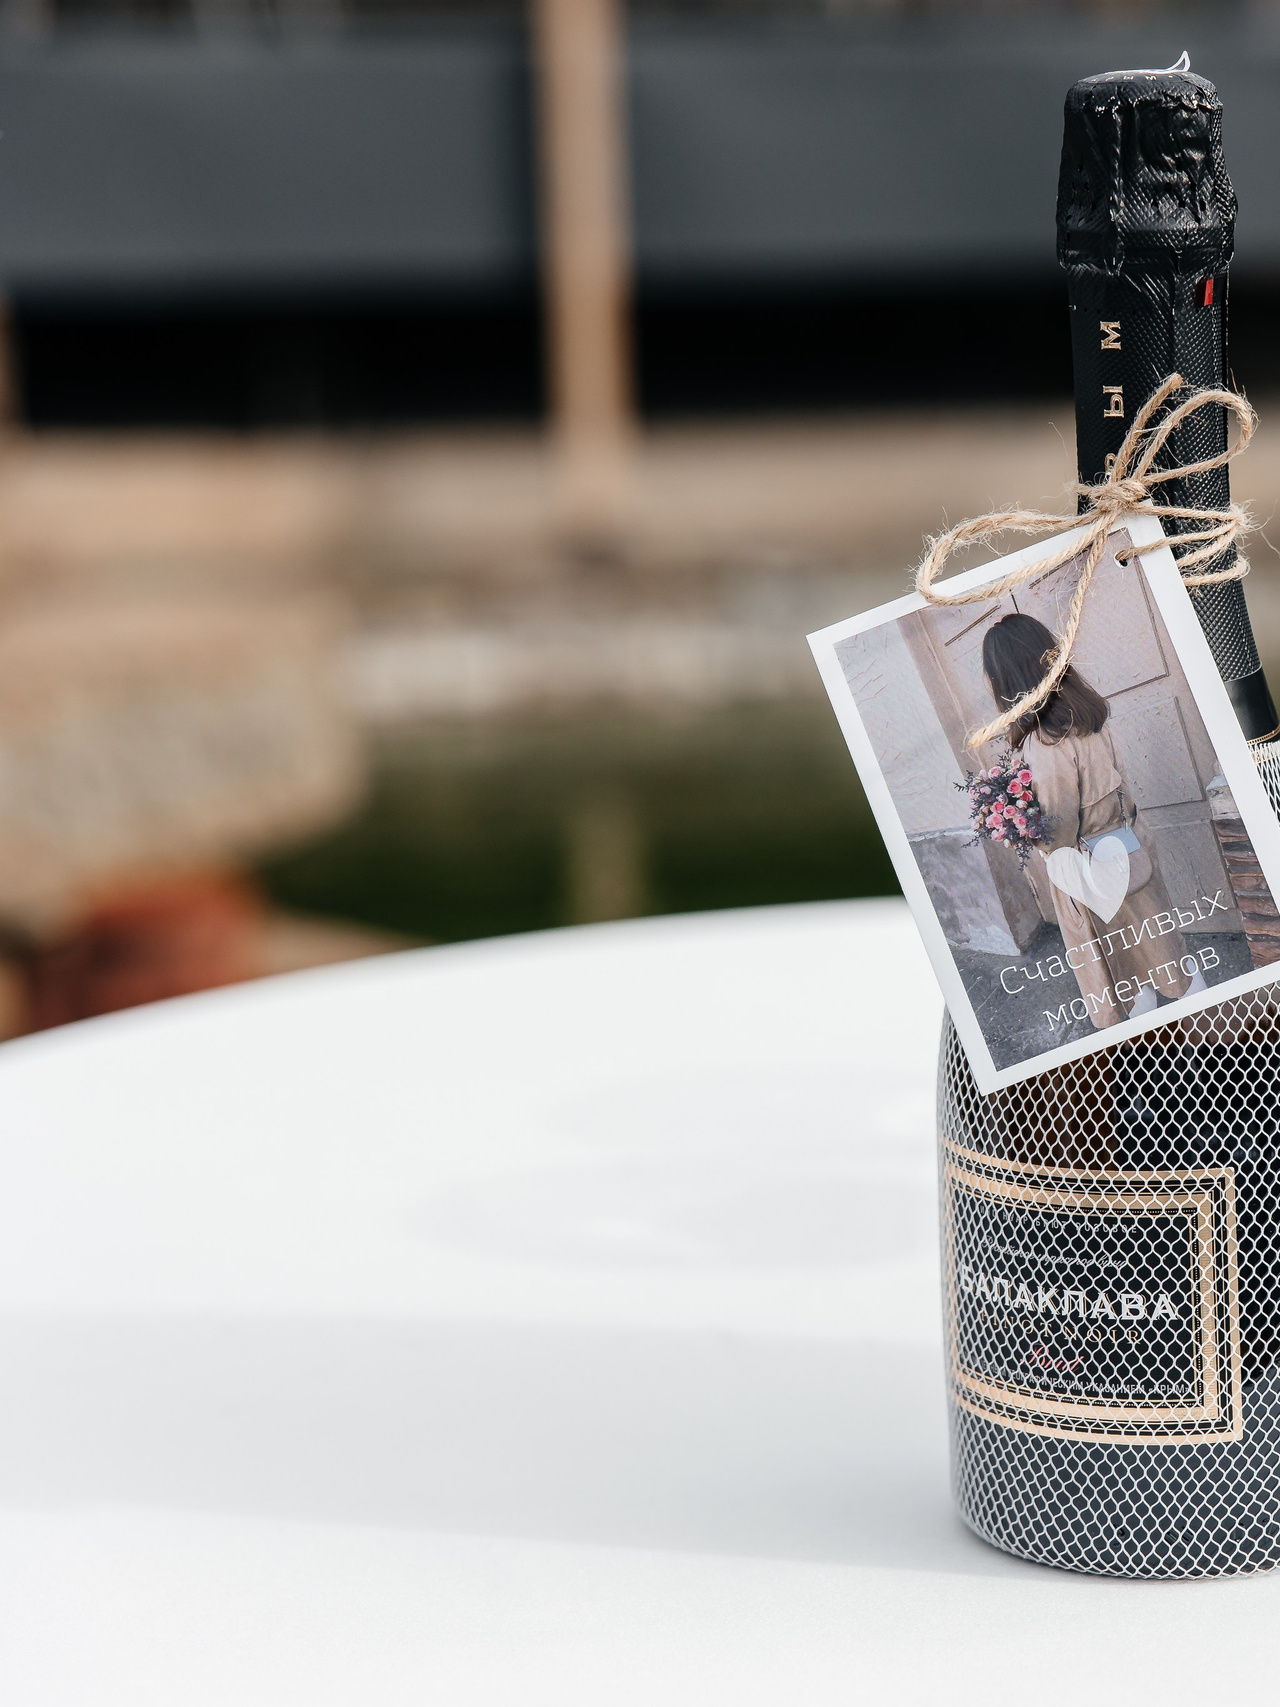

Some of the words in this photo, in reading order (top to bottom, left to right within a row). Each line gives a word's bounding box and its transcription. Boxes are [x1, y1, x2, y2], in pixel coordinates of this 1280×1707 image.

[998, 889, 1229, 995] Счастливых
[1042, 945, 1221, 1032] моментов
[960, 1263, 1181, 1321] БАЛАКЛАВА
[1063, 1324, 1143, 1345] NOIR
